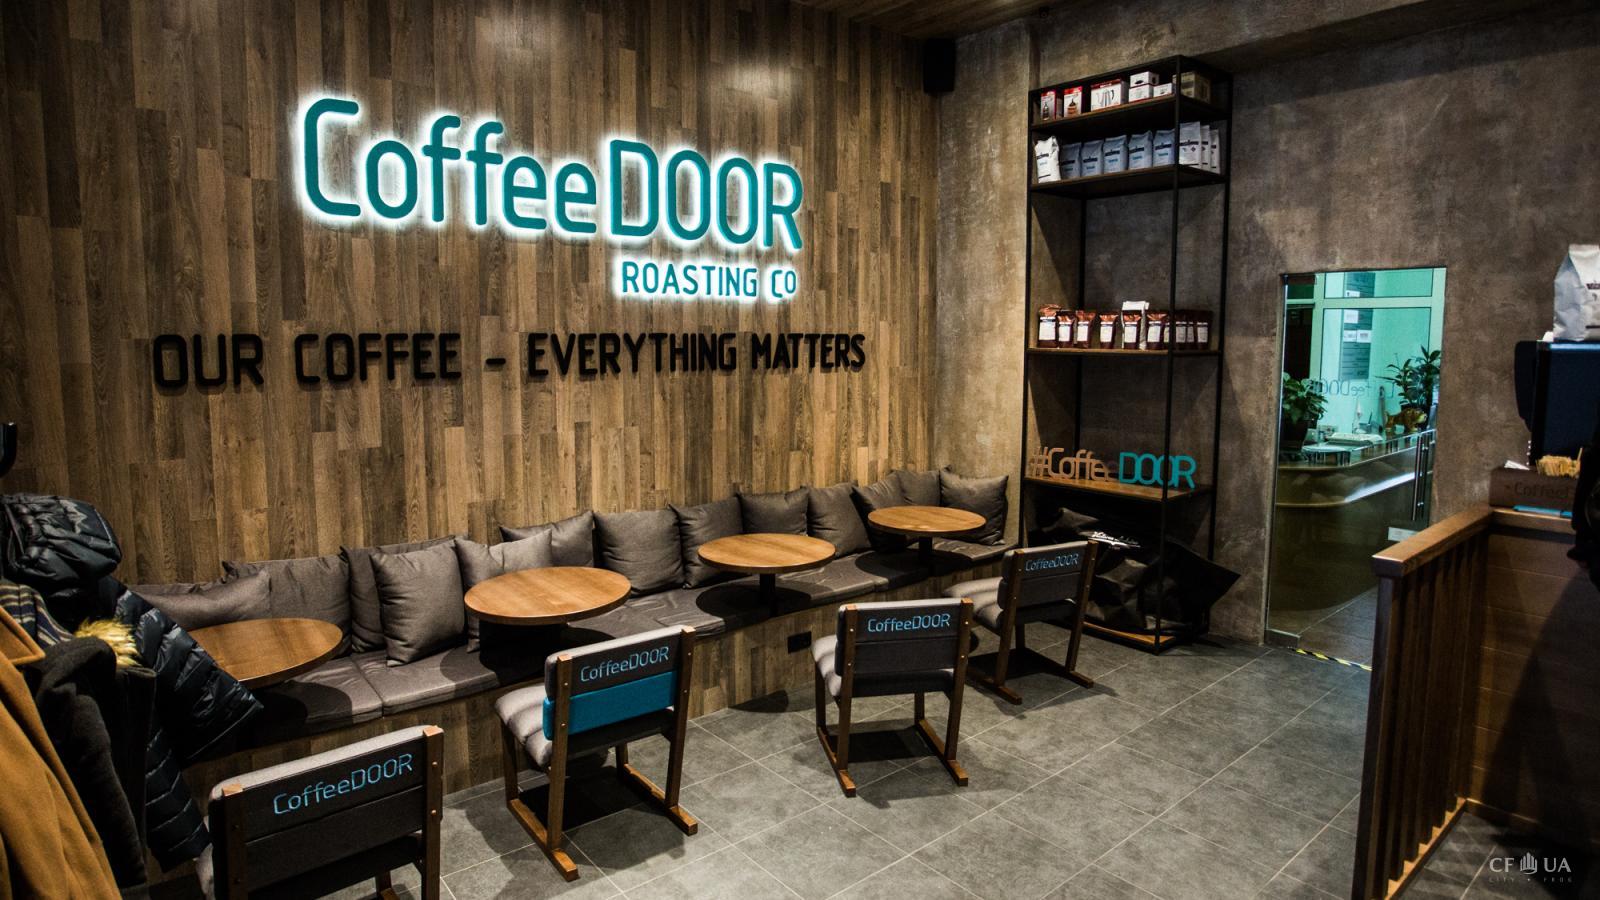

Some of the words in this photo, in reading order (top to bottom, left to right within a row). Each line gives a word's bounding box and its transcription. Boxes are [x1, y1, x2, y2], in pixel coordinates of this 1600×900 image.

[304, 98, 804, 250] CoffeeDOOR
[622, 261, 758, 298] ROASTING
[153, 334, 264, 386] OUR
[294, 333, 462, 384] COFFEE
[528, 332, 737, 376] EVERYTHING
[751, 332, 866, 370] MATTERS
[867, 611, 952, 633] CoffeeDOOR
[580, 645, 670, 683] CoffeeDOOR
[273, 753, 414, 815] CoffeeDOOR
